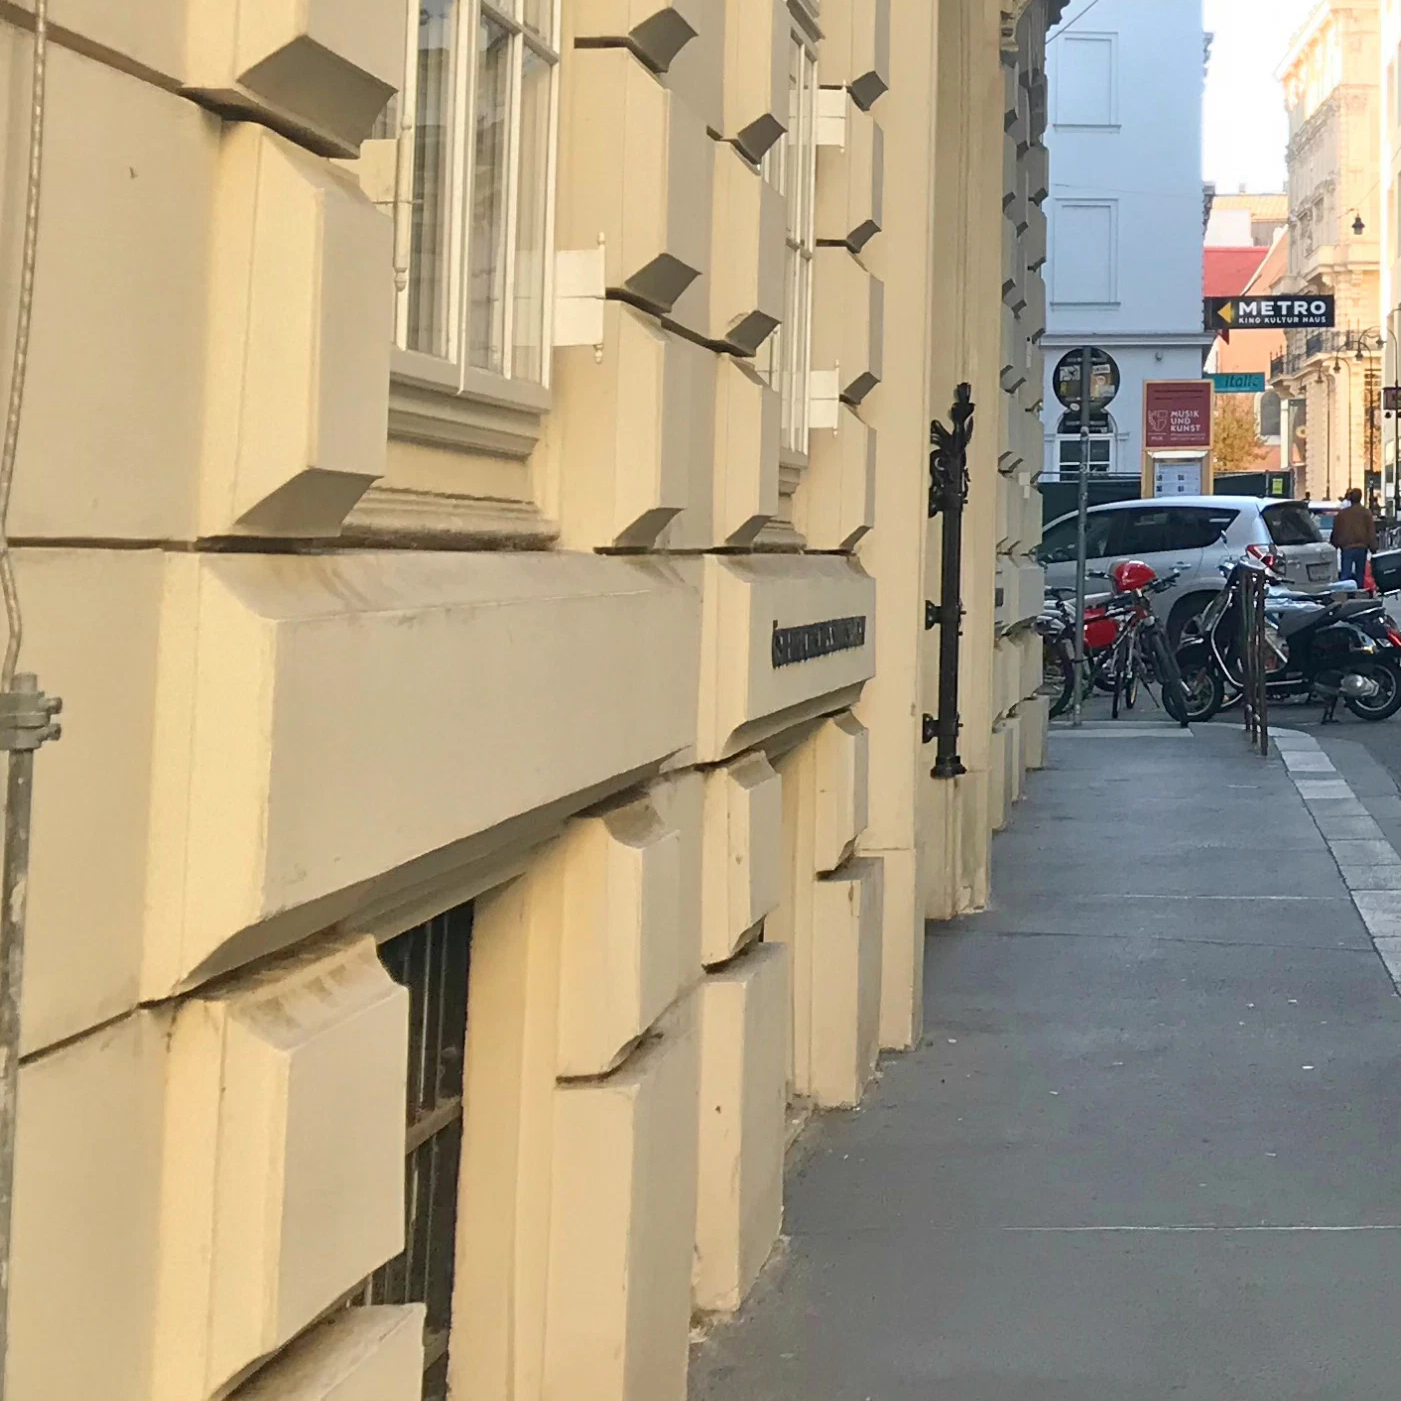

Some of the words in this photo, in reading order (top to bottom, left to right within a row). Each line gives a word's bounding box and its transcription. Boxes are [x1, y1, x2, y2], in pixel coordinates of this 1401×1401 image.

[1239, 300, 1326, 316] METRO
[1238, 316, 1261, 324] KINO
[1264, 316, 1299, 324] KULTUR
[1302, 315, 1326, 324] HAUS
[1170, 410, 1200, 418] MUSIK
[1170, 417, 1191, 425] UND
[1170, 424, 1201, 432] KUNST
